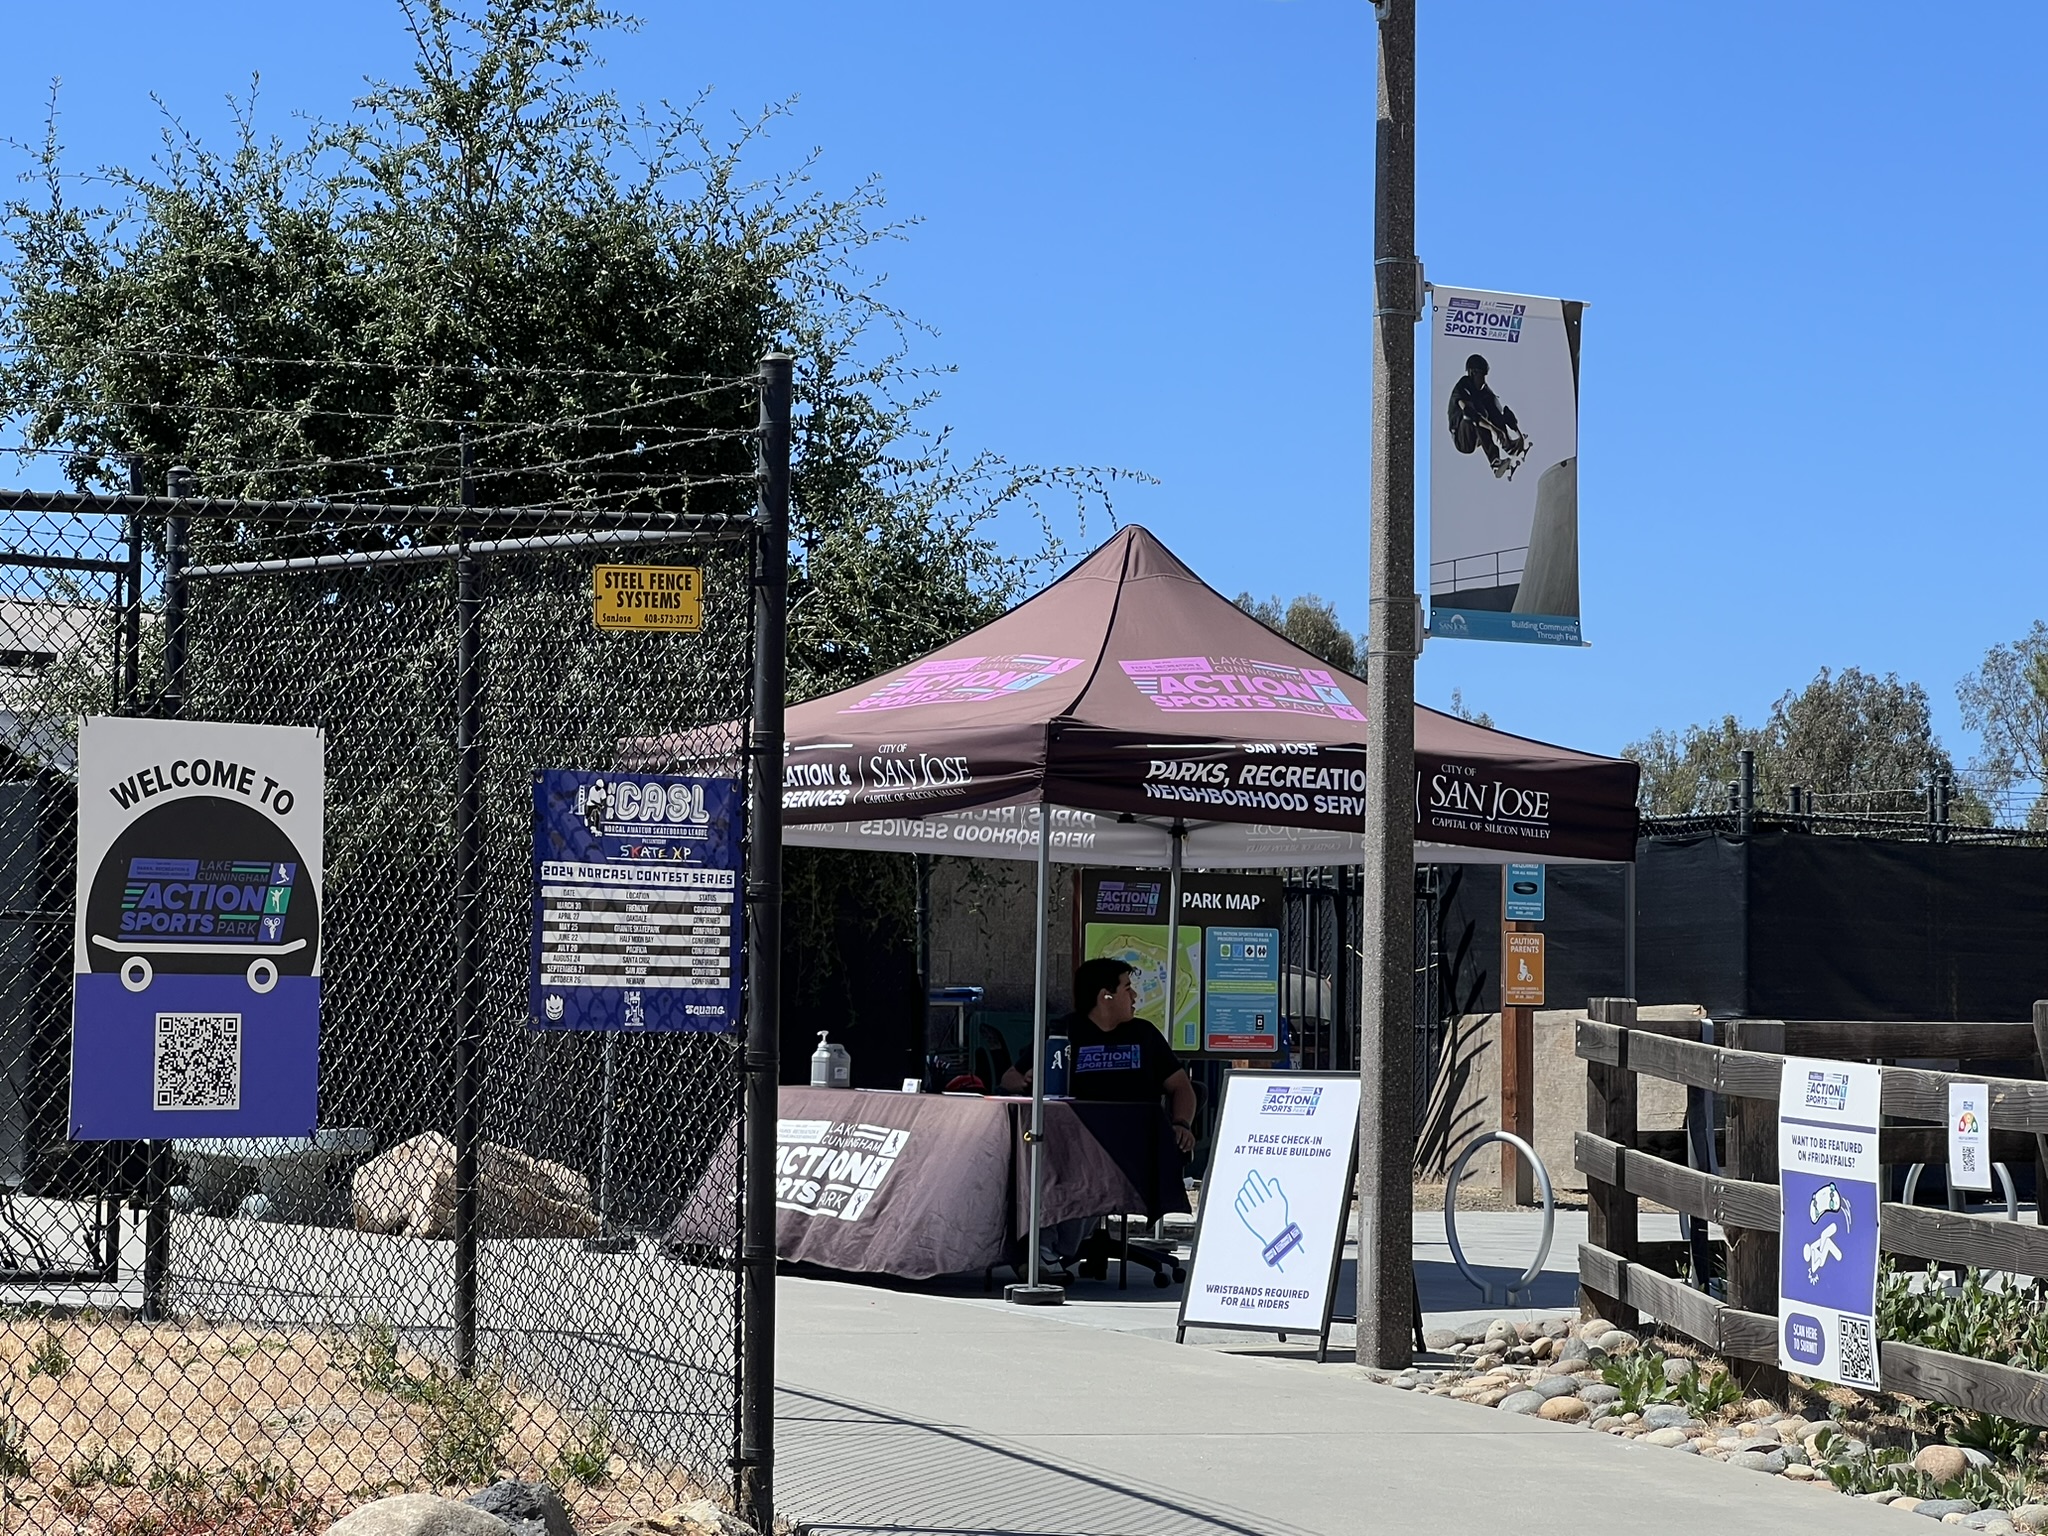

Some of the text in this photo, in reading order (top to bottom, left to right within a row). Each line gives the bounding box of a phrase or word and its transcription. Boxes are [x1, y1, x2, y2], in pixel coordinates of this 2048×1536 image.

[1453, 310, 1511, 328] ACTION
[1445, 323, 1487, 336] SPORTS
[1488, 330, 1507, 339] PARK
[605, 572, 692, 591] STEEL FENCE
[616, 591, 681, 609] SYSTEMS
[1511, 620, 1578, 633] Building Community
[1537, 631, 1564, 641] Through
[1209, 656, 1250, 667] LAKE
[1214, 665, 1304, 683] CUNNINGHAM
[887, 671, 1032, 694] ACTION
[1160, 674, 1318, 701] ACTION
[1150, 695, 1276, 709] SPORTS
[1279, 701, 1332, 715] PARK
[878, 743, 908, 754] CITY OF
[1242, 743, 1319, 756] SAN JOSE
[783, 764, 852, 787] ATION &
[870, 753, 973, 789] SAN JOSE
[1145, 760, 1366, 793] PARKS, RECREATIO
[1441, 763, 1477, 777] CITY OF
[109, 759, 295, 815] WELCOME TO
[615, 781, 710, 823] CASL
[782, 789, 851, 809] SERVICES
[864, 793, 894, 804] CAPITAL
[895, 793, 905, 803] OF
[1142, 783, 1366, 816] NEIGHBORHOOD SERV
[1430, 774, 1550, 821] SAN JOSE
[1431, 817, 1551, 840] CAPITAL OF SILICON VALLEY
[620, 845, 668, 858] SKATE
[201, 860, 232, 871] LAKE
[197, 872, 269, 883] CUNNINGHAM
[543, 865, 733, 885] 2024 NORCASL CONTEST SERIES
[138, 883, 266, 911] ACTION
[626, 891, 650, 899] LOCATION
[1103, 891, 1149, 903] ACTION
[1182, 892, 1260, 910] PARK MAP
[557, 901, 574, 909] MARCH
[1096, 903, 1130, 912] SPORTS
[120, 911, 215, 933] SPORTS
[558, 912, 572, 920] APRIL
[216, 921, 258, 935] PARK
[559, 922, 570, 930] MAY
[1510, 937, 1539, 945] CAUTION
[1510, 946, 1539, 954] PARENTS
[622, 956, 638, 964] SANTA
[547, 965, 577, 973] SEPTEMBER
[578, 965, 585, 974] 21
[550, 975, 573, 983] OCTOBER
[1083, 1051, 1131, 1062] ACTION
[1077, 1061, 1113, 1069] SPORTS
[1810, 1083, 1840, 1096] ACTION
[1268, 1095, 1311, 1105] ACTION
[1806, 1095, 1828, 1105] SPORTS
[1261, 1105, 1293, 1113] SPORTS
[1247, 1134, 1323, 1146] PLEASE CHECK-IN
[1791, 1134, 1863, 1154] WANT TO BE FEATURED
[1234, 1145, 1332, 1158] AT THE BLUE BUILDING
[1798, 1150, 1855, 1168] ON #FRIDAYFAILS?
[1206, 1284, 1310, 1300] WRISTBANDS REQUIRED
[1221, 1297, 1290, 1310] FOR ALL RIDERS
[1793, 1323, 1817, 1340] SCAN HERE
[1793, 1338, 1818, 1355] TO SUBMIT
